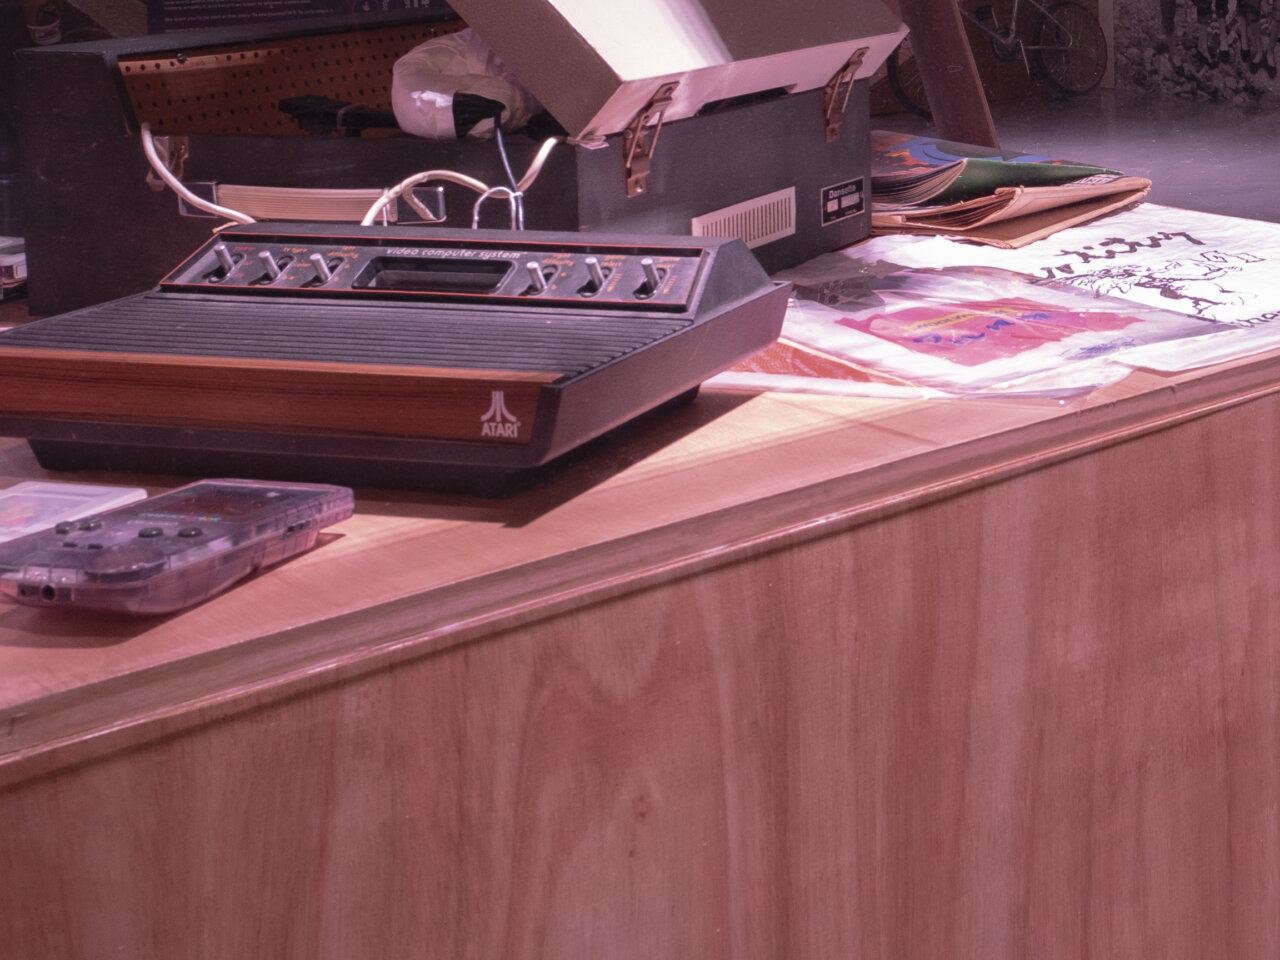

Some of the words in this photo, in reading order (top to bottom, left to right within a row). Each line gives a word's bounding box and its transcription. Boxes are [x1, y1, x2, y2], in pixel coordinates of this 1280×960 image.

[386, 248, 419, 256] video
[421, 249, 478, 259] computer
[478, 251, 521, 260] system
[481, 421, 519, 438] ATARI
